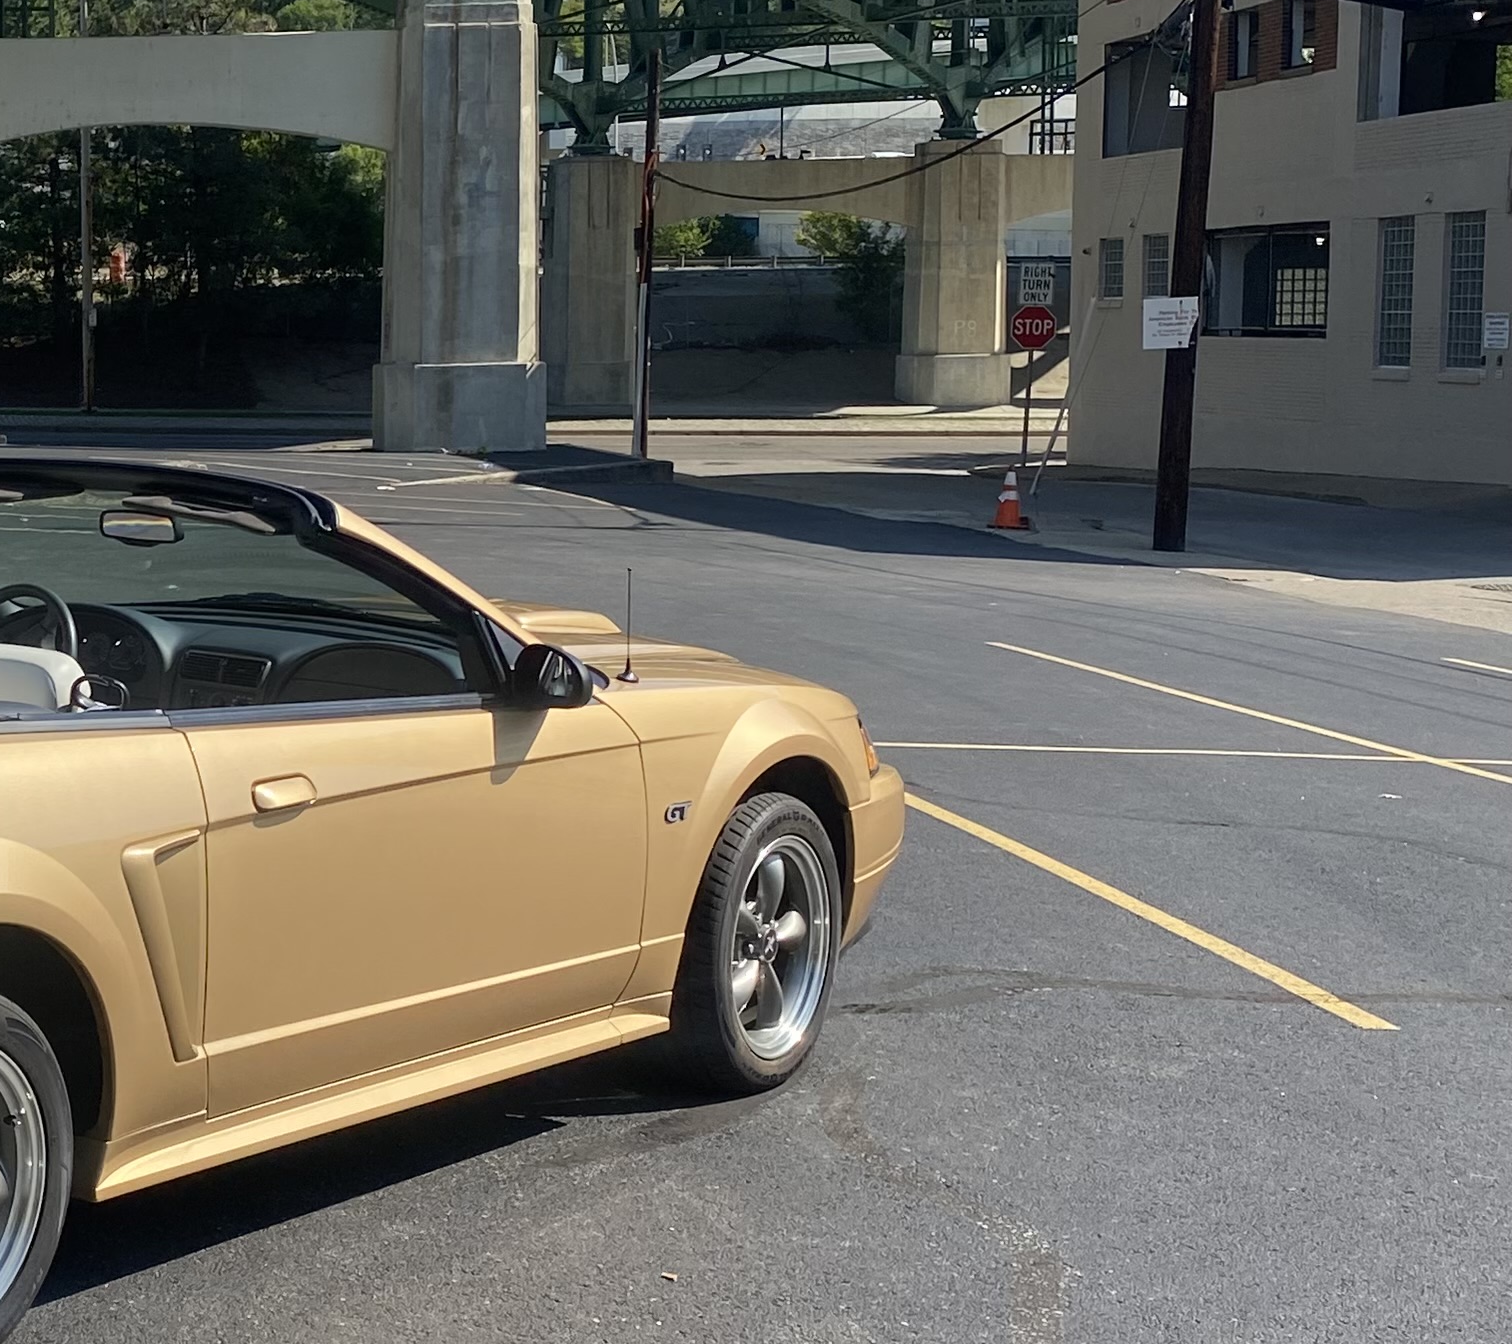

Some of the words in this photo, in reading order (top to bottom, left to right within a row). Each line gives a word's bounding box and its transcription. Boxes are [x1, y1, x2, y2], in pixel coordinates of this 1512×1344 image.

[1024, 266, 1052, 277] RIGHT
[1022, 279, 1051, 290] TURN
[1024, 292, 1048, 302] ONLY
[1014, 319, 1053, 335] STOP
[664, 801, 692, 824] GT
